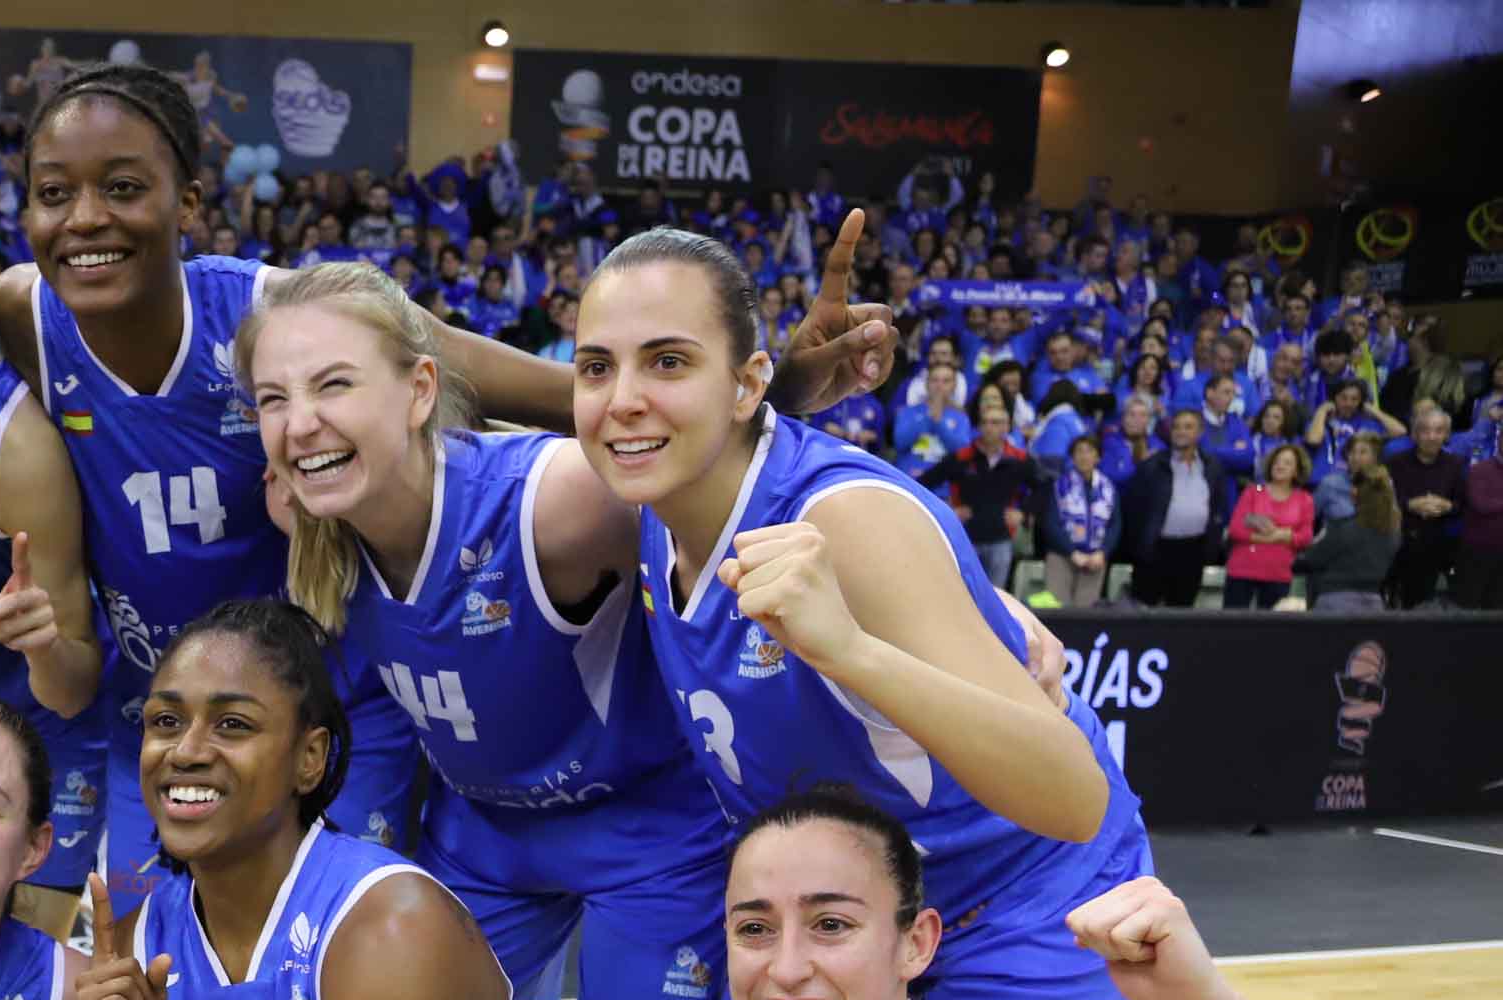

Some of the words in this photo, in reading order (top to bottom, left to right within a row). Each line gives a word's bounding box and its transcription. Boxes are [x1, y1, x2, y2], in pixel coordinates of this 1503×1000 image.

[631, 69, 743, 97] endesa
[628, 105, 744, 147] COPA
[644, 146, 751, 181] REINA
[121, 466, 227, 554] 14
[462, 616, 512, 637] AVENIDA
[737, 660, 788, 679] AVENIDA
[378, 661, 478, 742] 44
[1322, 775, 1365, 795] COPA
